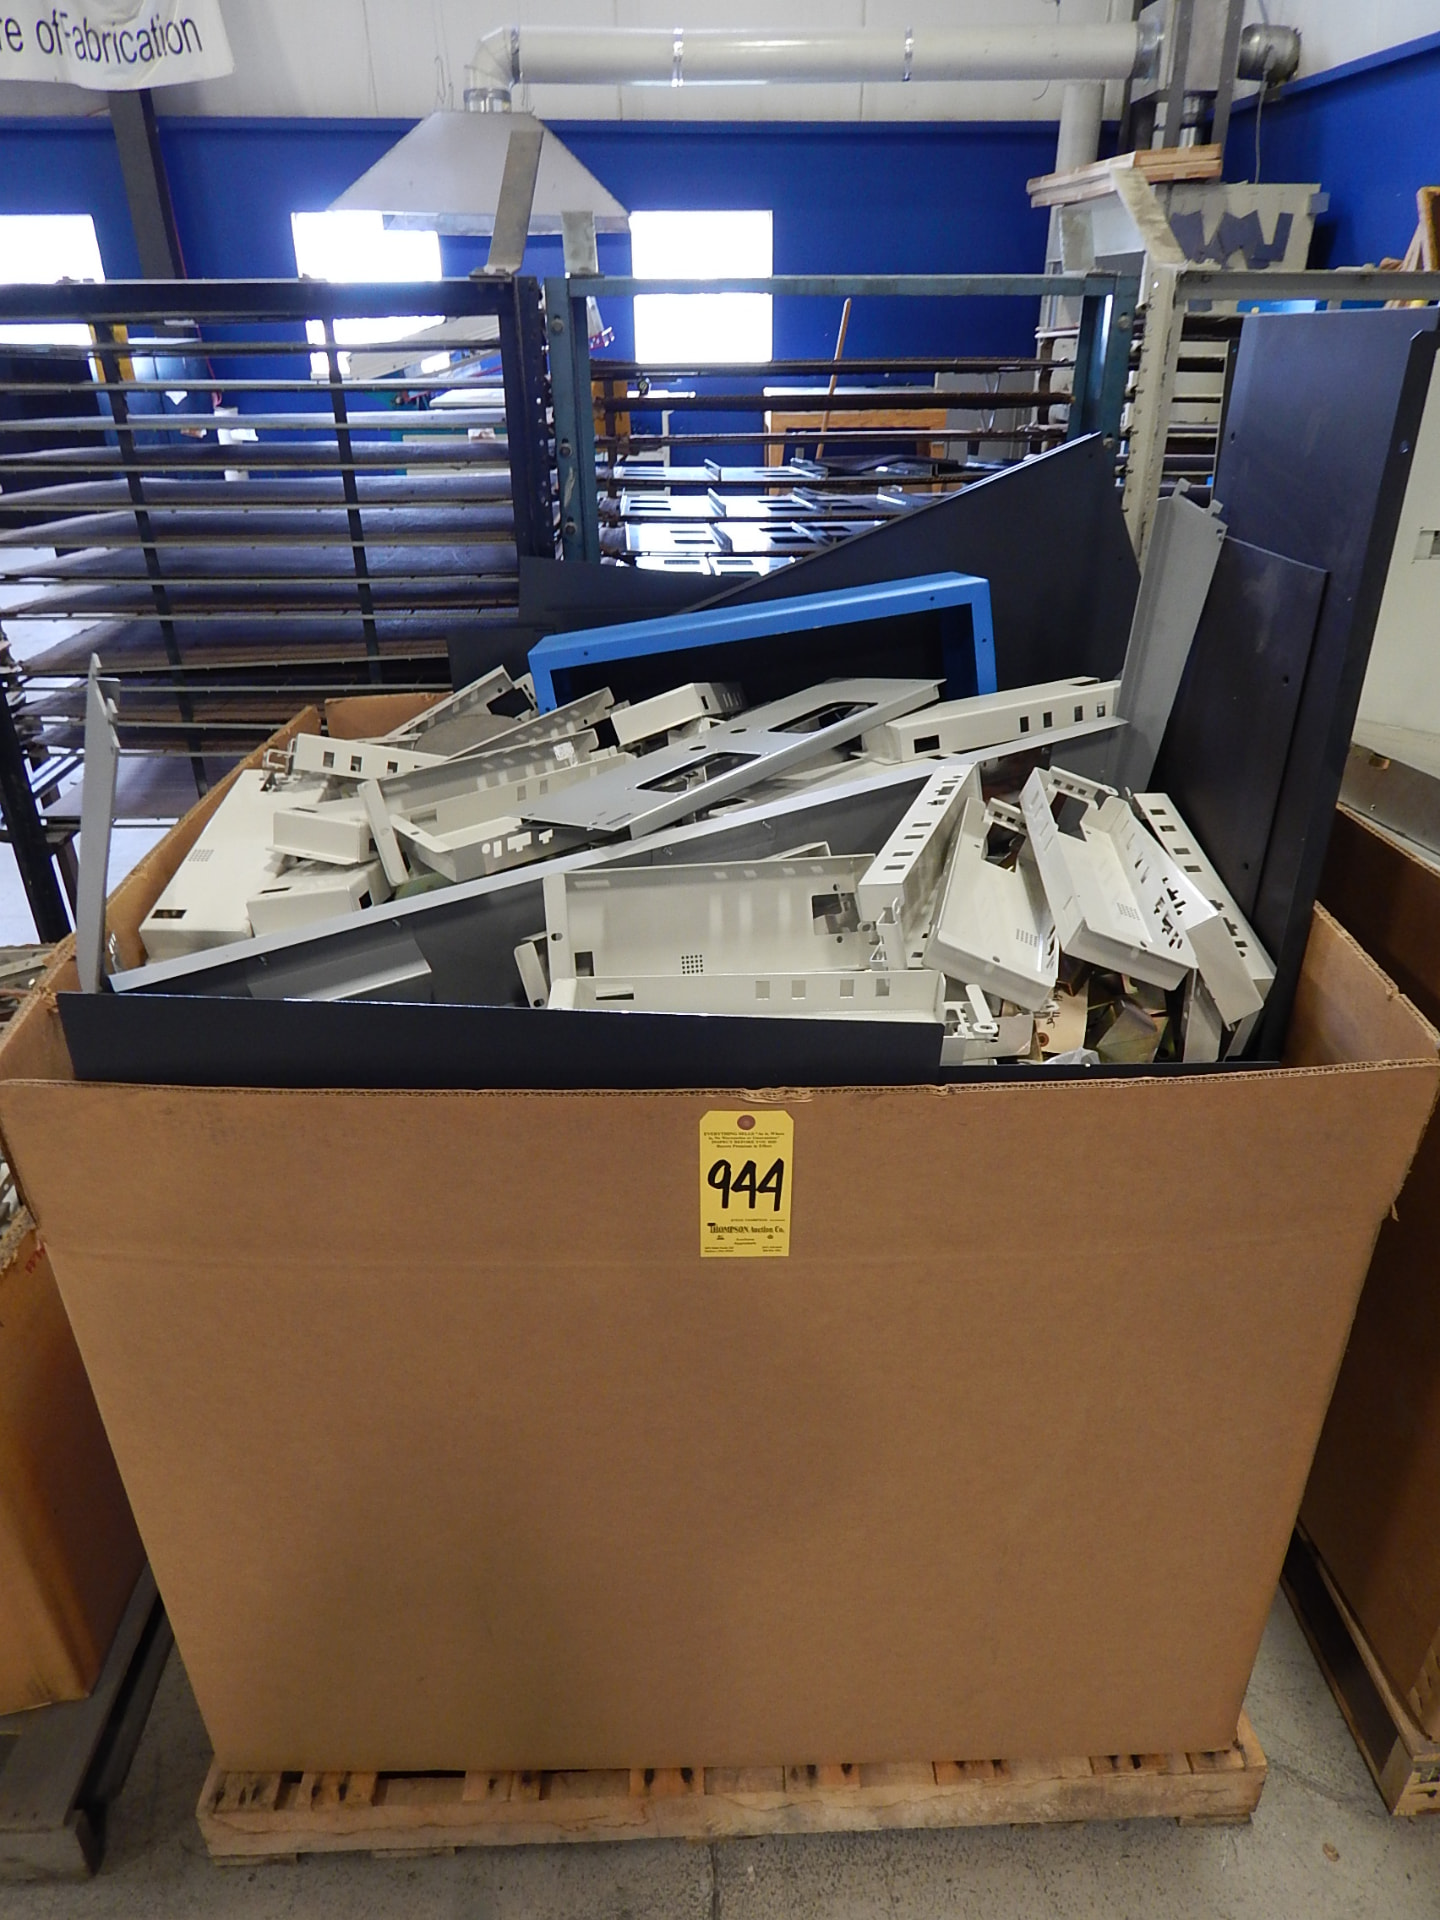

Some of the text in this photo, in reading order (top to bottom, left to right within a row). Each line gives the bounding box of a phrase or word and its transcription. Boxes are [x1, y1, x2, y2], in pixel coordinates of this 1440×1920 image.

[0, 17, 23, 52] e
[36, 9, 63, 55] of
[707, 1158, 784, 1212] 944
[707, 1223, 749, 1233] THOMPSON
